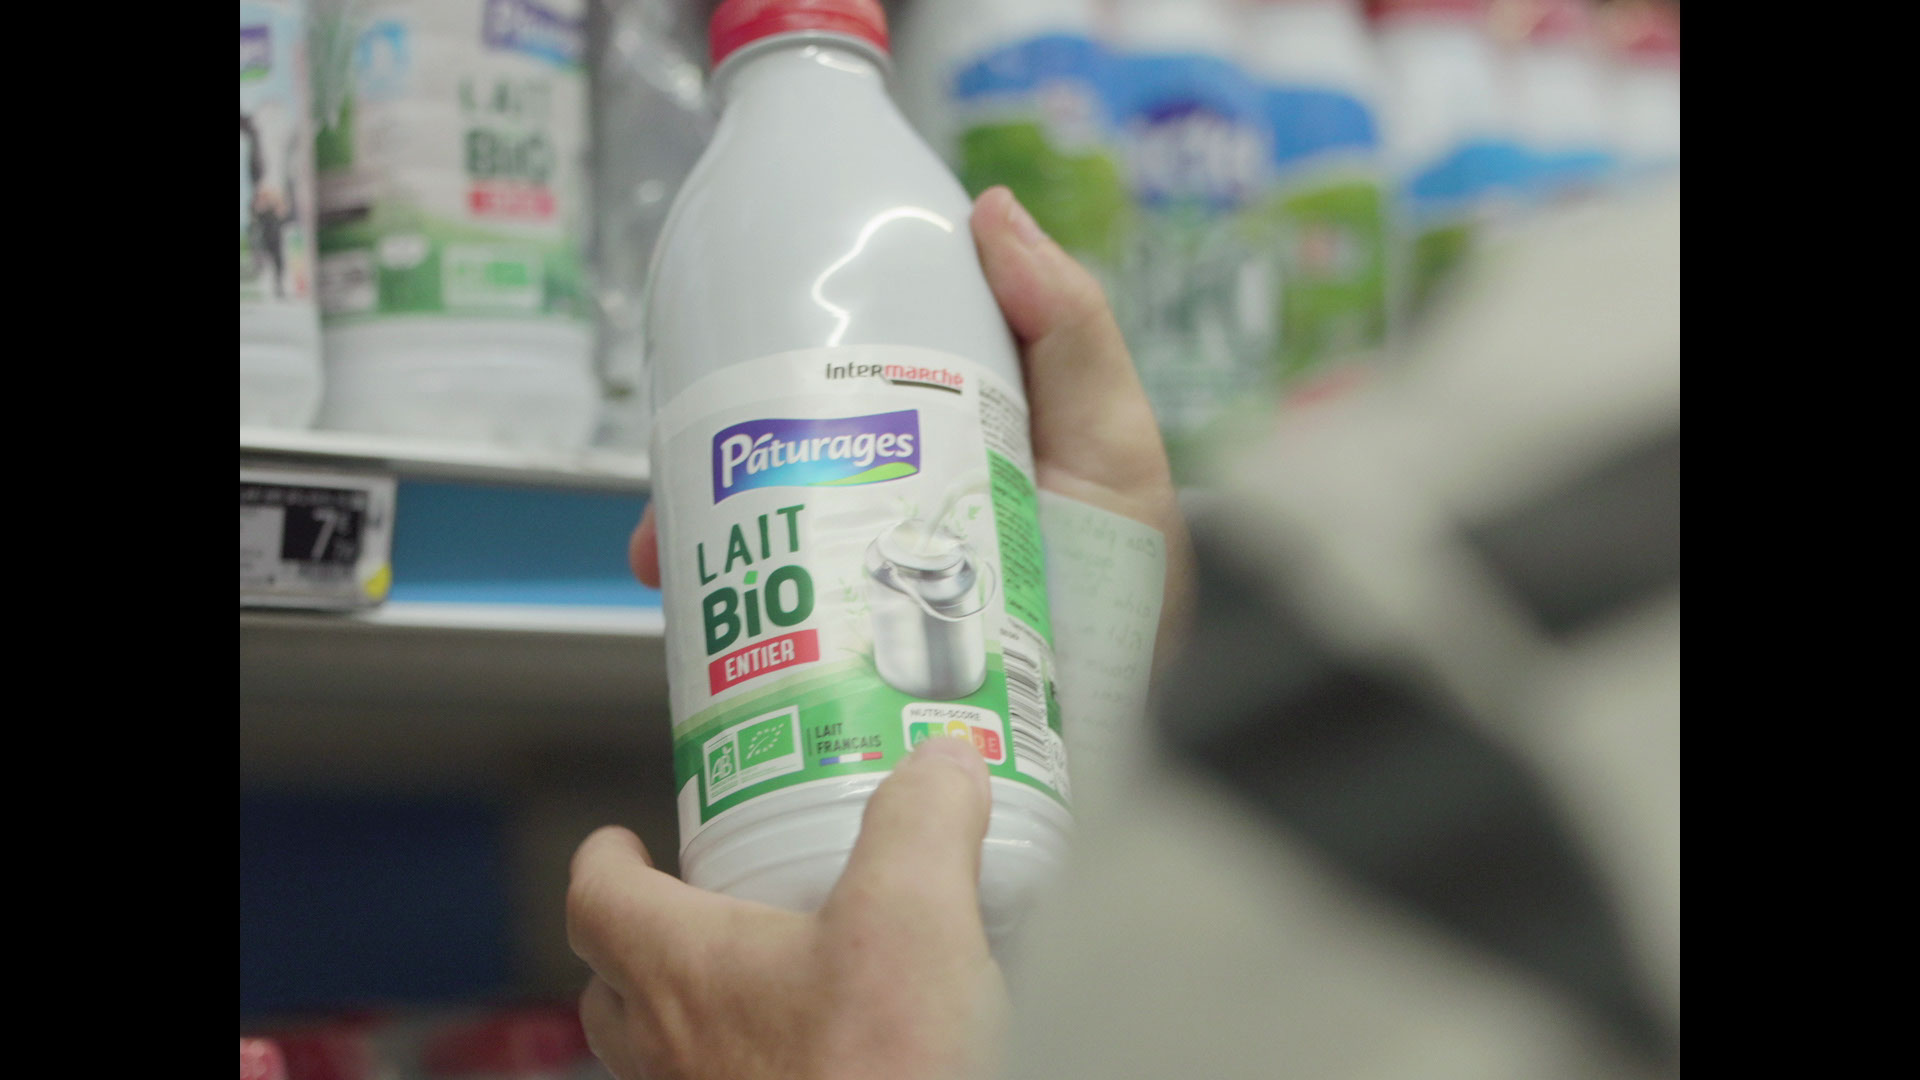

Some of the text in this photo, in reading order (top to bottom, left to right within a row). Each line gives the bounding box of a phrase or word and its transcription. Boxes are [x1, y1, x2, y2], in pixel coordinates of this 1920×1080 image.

[697, 504, 805, 586] LAIT
[724, 638, 795, 682] ENTIER
[815, 723, 843, 738] LAIT
